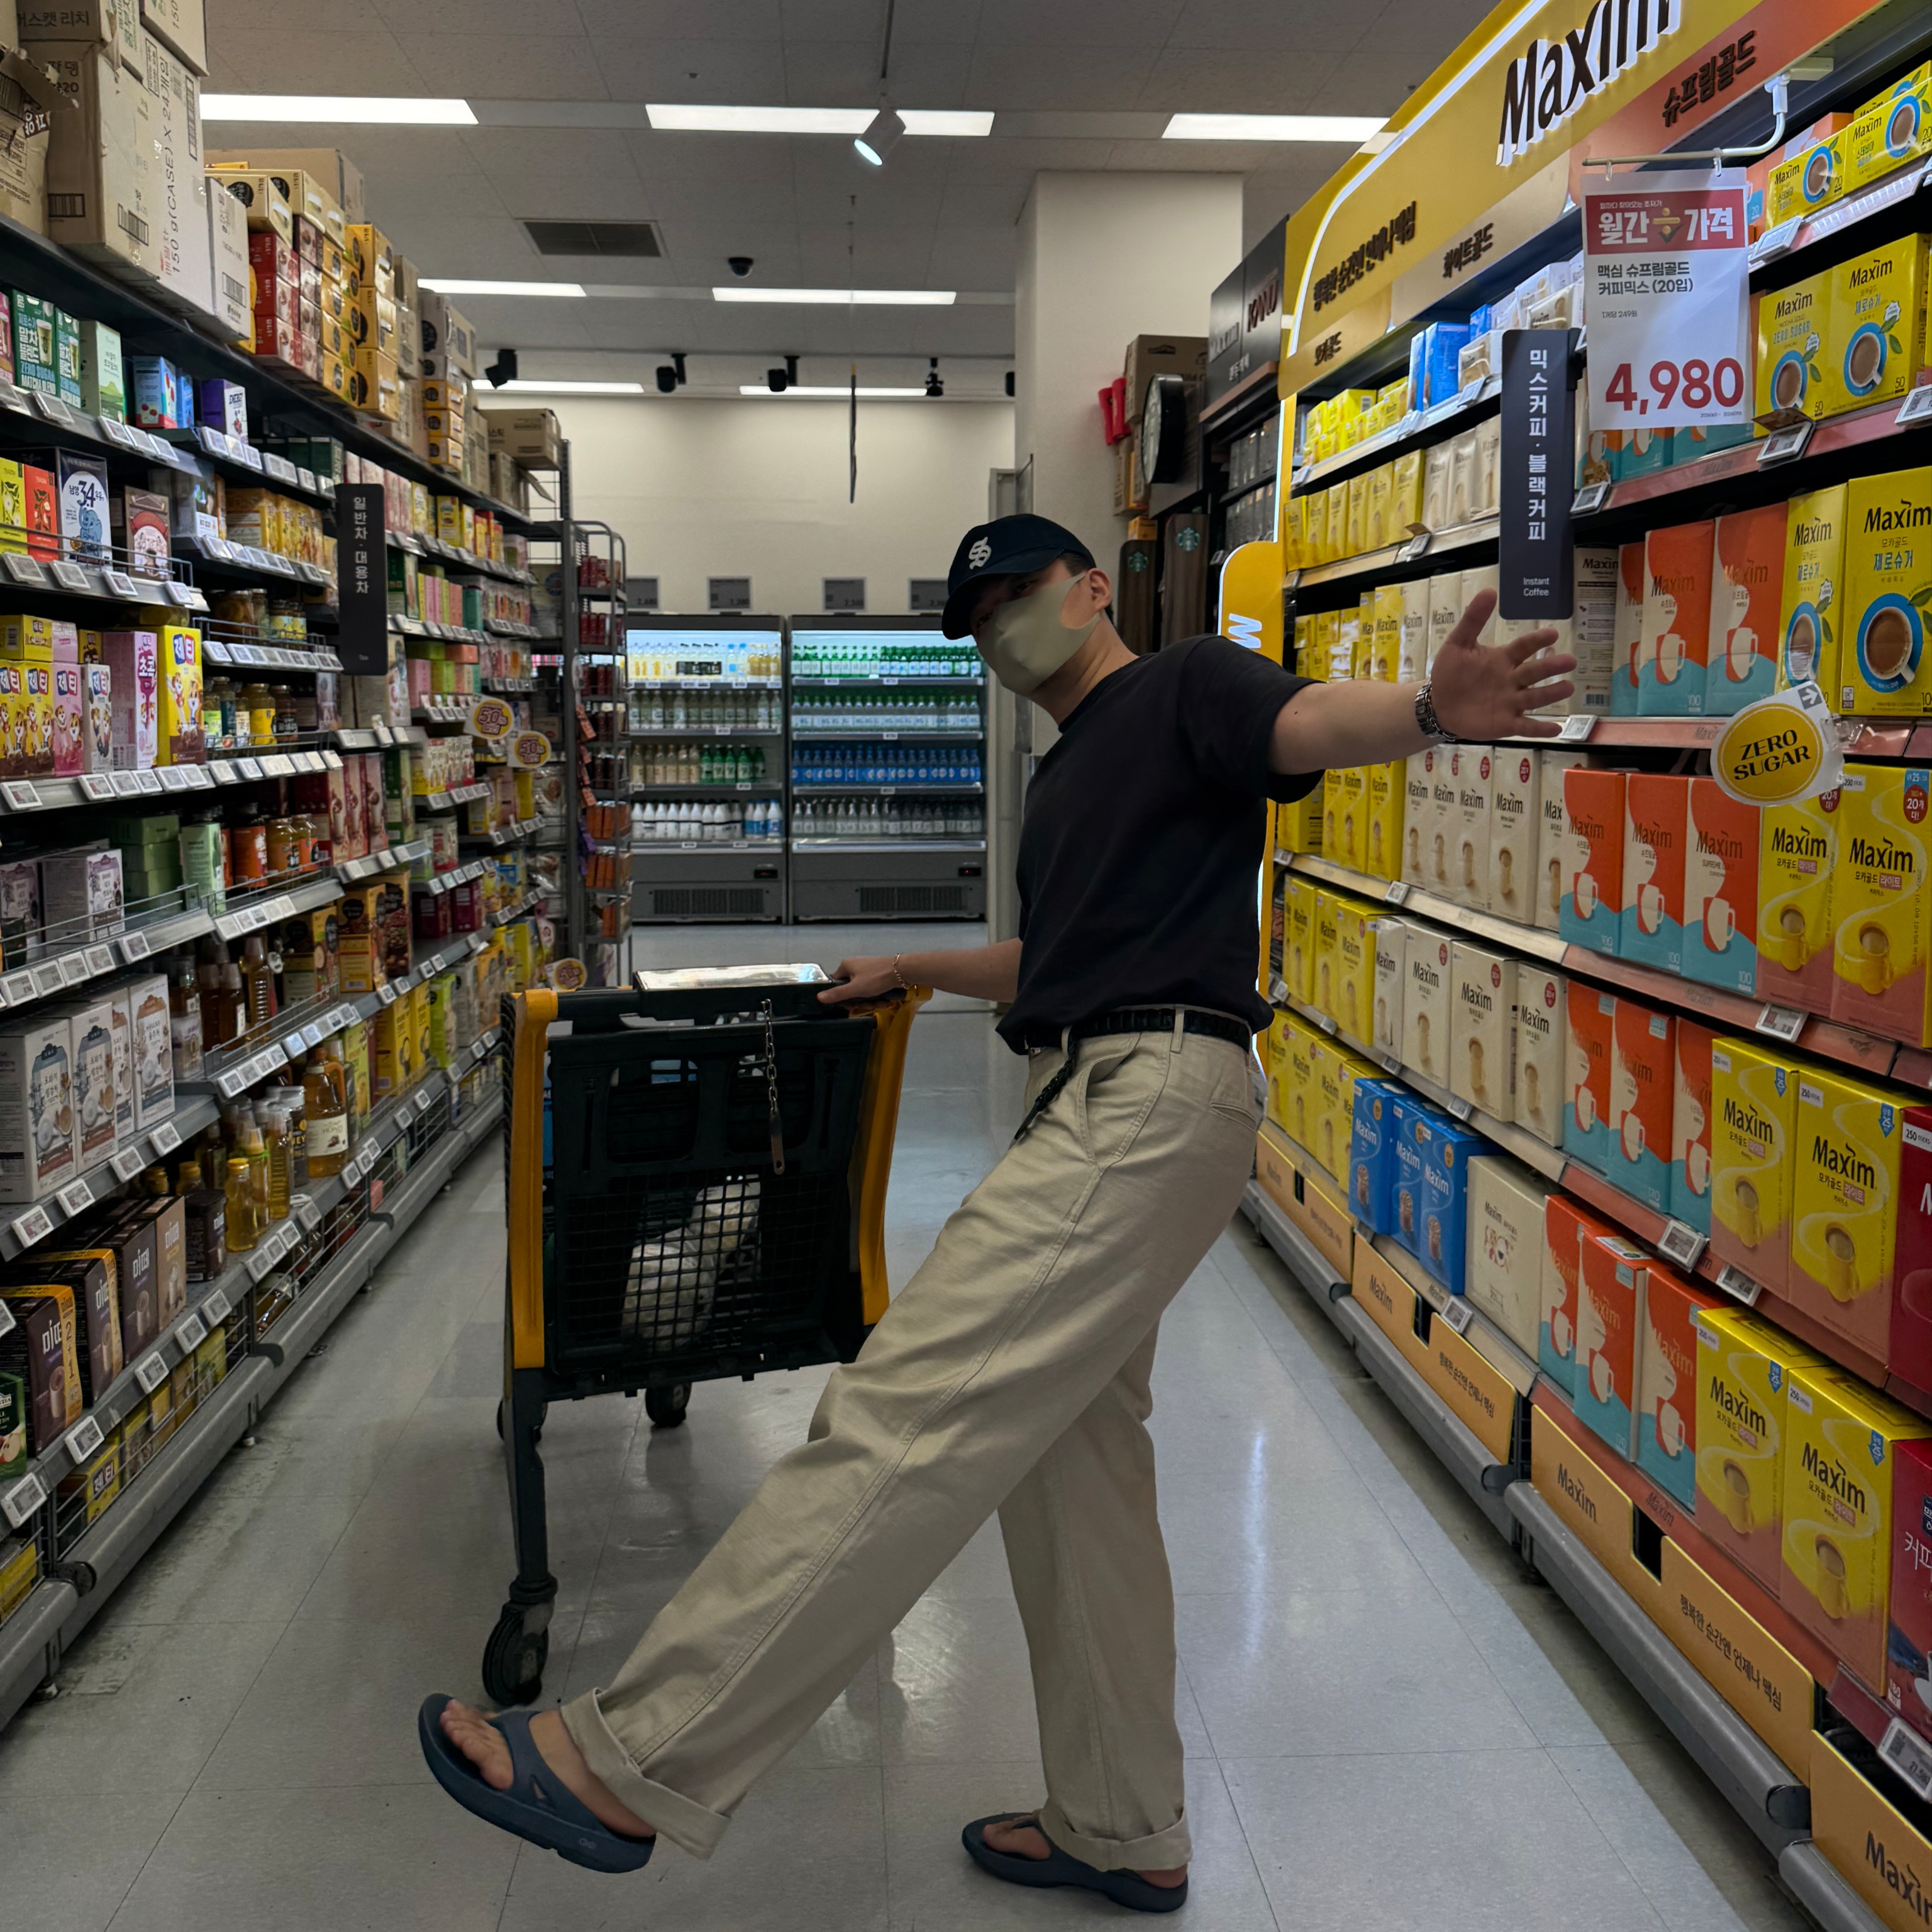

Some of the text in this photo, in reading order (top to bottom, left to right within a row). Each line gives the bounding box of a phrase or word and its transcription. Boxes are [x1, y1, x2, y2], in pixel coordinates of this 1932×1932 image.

[60, 11, 89, 26] 리치
[1662, 30, 1758, 127] 슈프림골드
[1852, 116, 1883, 142] Maxim
[1774, 162, 1800, 186] Maxim
[1834, 175, 1843, 188] 20
[1394, 200, 1417, 245] 맥심
[1598, 207, 1734, 245] 월간 가격
[1443, 222, 1494, 278] 화이트골드
[1597, 261, 1690, 279] 맥심 슈프림골드
[1848, 258, 1893, 289] Maxim
[1598, 277, 1694, 296] 커피믹스 (20입)
[1774, 292, 1813, 320] Maxim
[1854, 293, 1882, 316] 제로슈거
[19, 326, 38, 346] 말차
[1773, 320, 1812, 346] ZERO SUGAR
[1314, 331, 1342, 366] 모카골드
[1604, 357, 1745, 416] 4,980
[1894, 376, 1906, 389] 50
[1814, 401, 1824, 413] 50
[1527, 348, 1548, 541] 믹스커피·블랙커피
[77, 480, 96, 508] 3.4
[1863, 497, 1932, 534] Maxim
[1794, 515, 1833, 547] Maxim
[1881, 536, 1909, 549] 모카골드
[1723, 559, 1769, 587] Maxim
[1796, 562, 1821, 582] 제로슈거
[1873, 549, 1914, 572] 제로슈거
[1523, 577, 1550, 586] Instant
[1523, 587, 1550, 597] Coffee
[1651, 570, 1696, 598] Maxim
[172, 633, 196, 666] 제티
[27, 667, 50, 696] 제티
[56, 669, 79, 696] 제티
[92, 670, 109, 696] 제티
[1687, 694, 1702, 706] 100
[1740, 728, 1798, 761] ZERO
[1733, 745, 1812, 782] SUGAR
[1408, 780, 1429, 799] Maxim
[1433, 784, 1455, 804] Maxim
[1460, 788, 1484, 810] Maxim
[1496, 791, 1524, 815] Maxim
[1906, 798, 1925, 811] 20개
[1568, 814, 1605, 840] Maxim
[1632, 821, 1673, 848] Maxim
[1772, 824, 1828, 858] Maxim
[1696, 830, 1743, 860] Maxim
[1849, 836, 1914, 874] Maxim
[1776, 858, 1817, 873] 모카골드 라이트
[1855, 871, 1902, 889] 모카골드 라이트
[1413, 960, 1440, 988] Maxim
[1738, 970, 1753, 987] 100
[1461, 982, 1492, 1011] Maxim
[1520, 1005, 1550, 1034] Maxim
[1355, 1118, 1377, 1146] Maxim
[1723, 1097, 1774, 1144] Maxim
[1882, 1118, 1891, 1128] 25
[1906, 1128, 1918, 1141] 250
[1729, 1131, 1748, 1148] 모카골드
[1395, 1140, 1421, 1170] Maxim
[1812, 1135, 1875, 1189] Maxim
[1424, 1163, 1449, 1196] Maxim
[1818, 1172, 1843, 1192] 모카골드
[1368, 1274, 1394, 1314] Maxim
[1587, 1285, 1621, 1330] Maxim
[1653, 1327, 1694, 1378] Maxim
[1710, 1375, 1766, 1436] Maxim
[1801, 1442, 1865, 1514] Maxim
[1557, 1462, 1598, 1524] Maxim
[1808, 1480, 1833, 1506] 모카골드
[1645, 1491, 1675, 1527] Maxim
[1679, 1594, 1782, 1713] 행복한 순간엔 언제나 맥심
